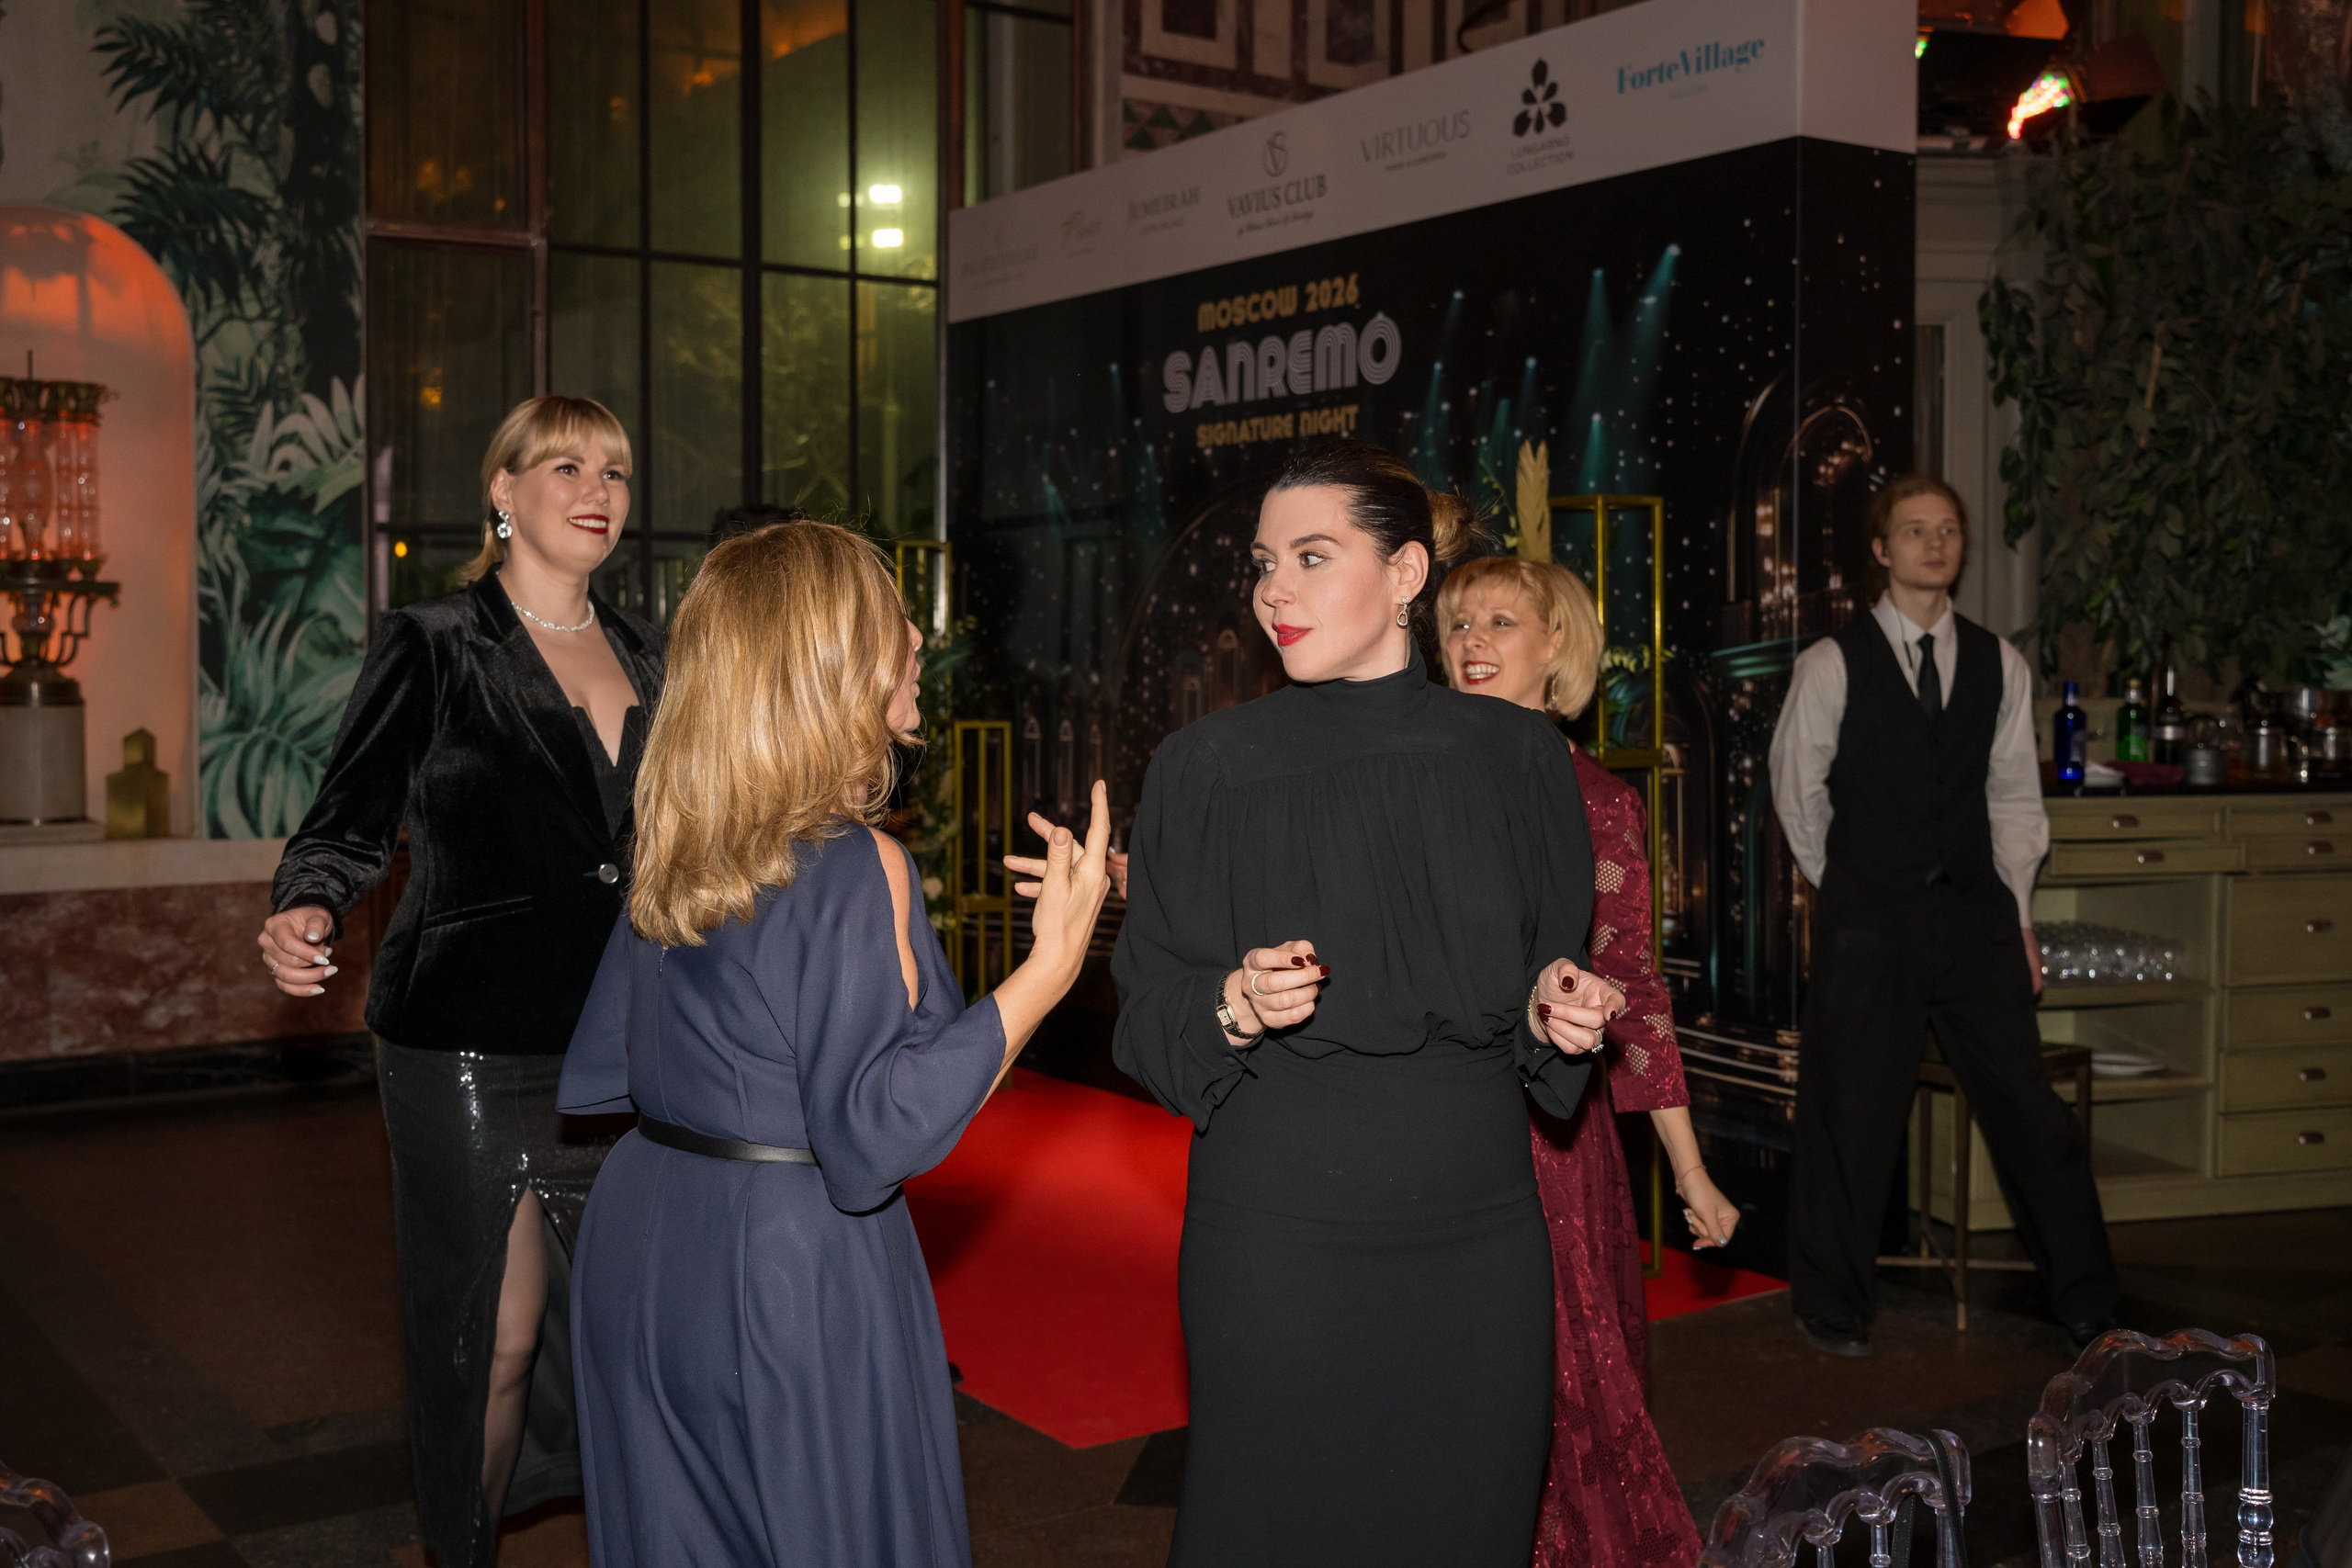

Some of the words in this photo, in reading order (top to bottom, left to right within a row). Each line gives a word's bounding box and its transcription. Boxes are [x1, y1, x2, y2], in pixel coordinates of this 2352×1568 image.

[1359, 108, 1470, 163] VIRTUOUS
[1506, 151, 1576, 175] COLLECTION
[1283, 174, 1327, 205] CLUB
[1197, 286, 1298, 333] MOSCOW
[1305, 273, 1360, 312] 2026
[1162, 314, 1403, 413] SANREMO
[1196, 413, 1294, 448] SIGNATURE
[1299, 404, 1360, 437] NIGHT
